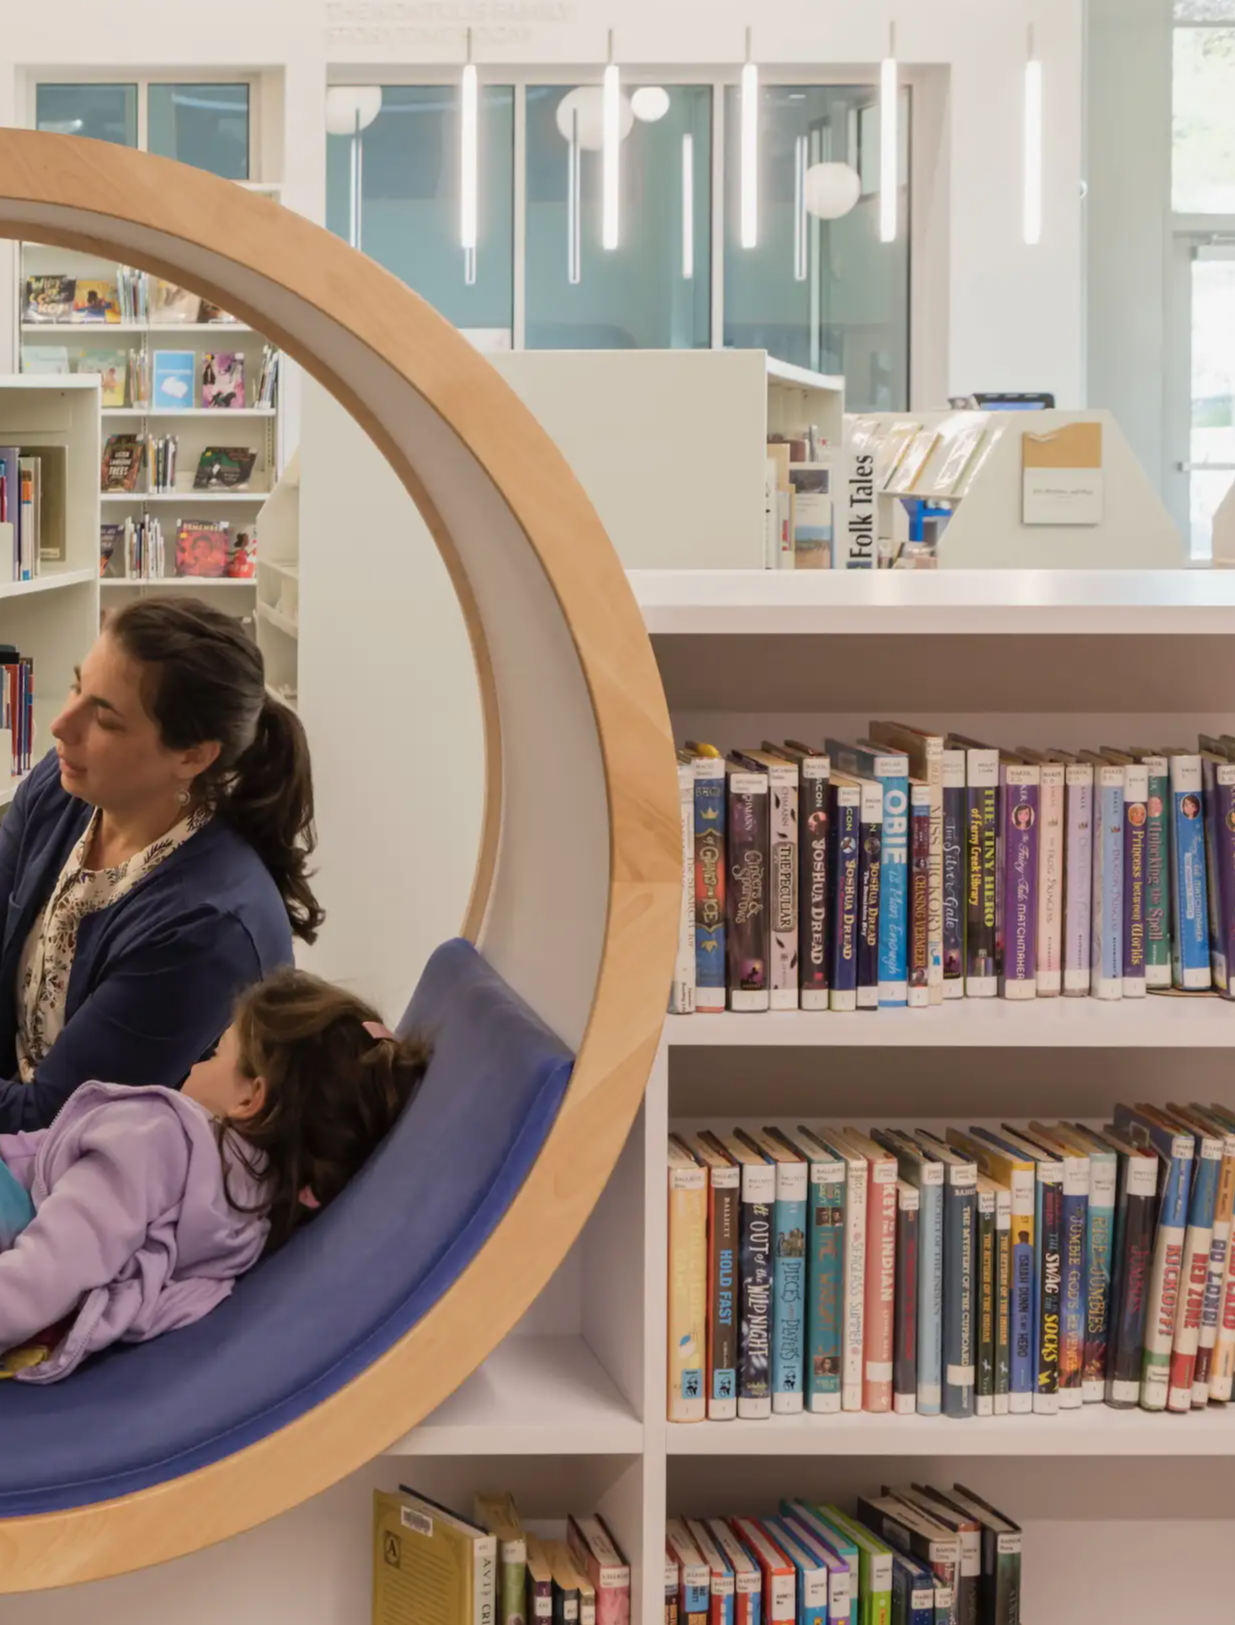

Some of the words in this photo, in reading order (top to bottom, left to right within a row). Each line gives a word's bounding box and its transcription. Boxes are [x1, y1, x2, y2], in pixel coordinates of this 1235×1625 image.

[849, 455, 873, 508] Tales
[849, 513, 873, 558] Folk
[970, 808, 981, 819] of
[984, 788, 995, 824] THE
[883, 789, 907, 865] OBIE
[968, 820, 980, 846] Ferny
[780, 846, 792, 870] THE
[811, 839, 826, 903] JOSHUA
[942, 842, 960, 887] Silver
[969, 847, 981, 872] Creek
[984, 831, 995, 871] TINY
[1131, 830, 1144, 878] Princess
[1147, 821, 1162, 884] Unlocking
[731, 865, 751, 924] Sparrows
[744, 850, 763, 899] Cinders
[844, 860, 856, 910] JOSHUA
[869, 862, 878, 905] JOSHUA
[968, 873, 981, 906] Library
[703, 899, 718, 923] ICE
[747, 902, 762, 918] &
[779, 872, 792, 927] PECULIAR
[888, 887, 902, 919] Man
[915, 875, 925, 918] CHASING
[984, 876, 995, 927] HERO
[1132, 881, 1144, 920] between
[1153, 888, 1161, 904] the
[810, 906, 826, 964] DREAD
[842, 914, 855, 960] DREAD
[867, 907, 878, 946] DREAD
[914, 920, 925, 967] VERMEER
[1015, 904, 1027, 979] MATCHMAKER
[1131, 923, 1144, 965] Worlds
[1148, 907, 1163, 940] Spell
[883, 924, 902, 974] Enough
[881, 1184, 894, 1218] KEY
[962, 1206, 971, 1226] THE
[750, 1221, 768, 1252] OUT
[961, 1228, 971, 1273] MYSTERY
[1068, 1216, 1081, 1265] JUMBIE
[1091, 1217, 1107, 1253] RISE
[718, 1250, 732, 1287] HOLD
[754, 1253, 767, 1264] of
[754, 1268, 768, 1283] the
[880, 1236, 893, 1302] INDIAN
[1018, 1254, 1030, 1284] ISAIAH
[1044, 1252, 1060, 1294] SWAG
[1192, 1253, 1208, 1283] RED
[746, 1284, 768, 1312] WILD
[780, 1262, 802, 1303] PIECES
[961, 1292, 970, 1310] THE
[962, 1275, 970, 1290] OF
[1018, 1286, 1030, 1312] DUNN
[1067, 1270, 1080, 1309] GOD'S
[1088, 1266, 1104, 1333] JUMBIES
[1158, 1244, 1181, 1336] KICKOFF!
[718, 1291, 732, 1326] FAST
[848, 1302, 863, 1346] SUMMER
[747, 1314, 769, 1358] NIGHT
[780, 1319, 801, 1360] PLAYERS
[960, 1311, 970, 1366] CUPBOARD
[1017, 1332, 1028, 1358] HERO
[1042, 1313, 1059, 1362] SOCKS
[1066, 1314, 1079, 1372] REVENGE
[482, 1558, 492, 1588] AVI
